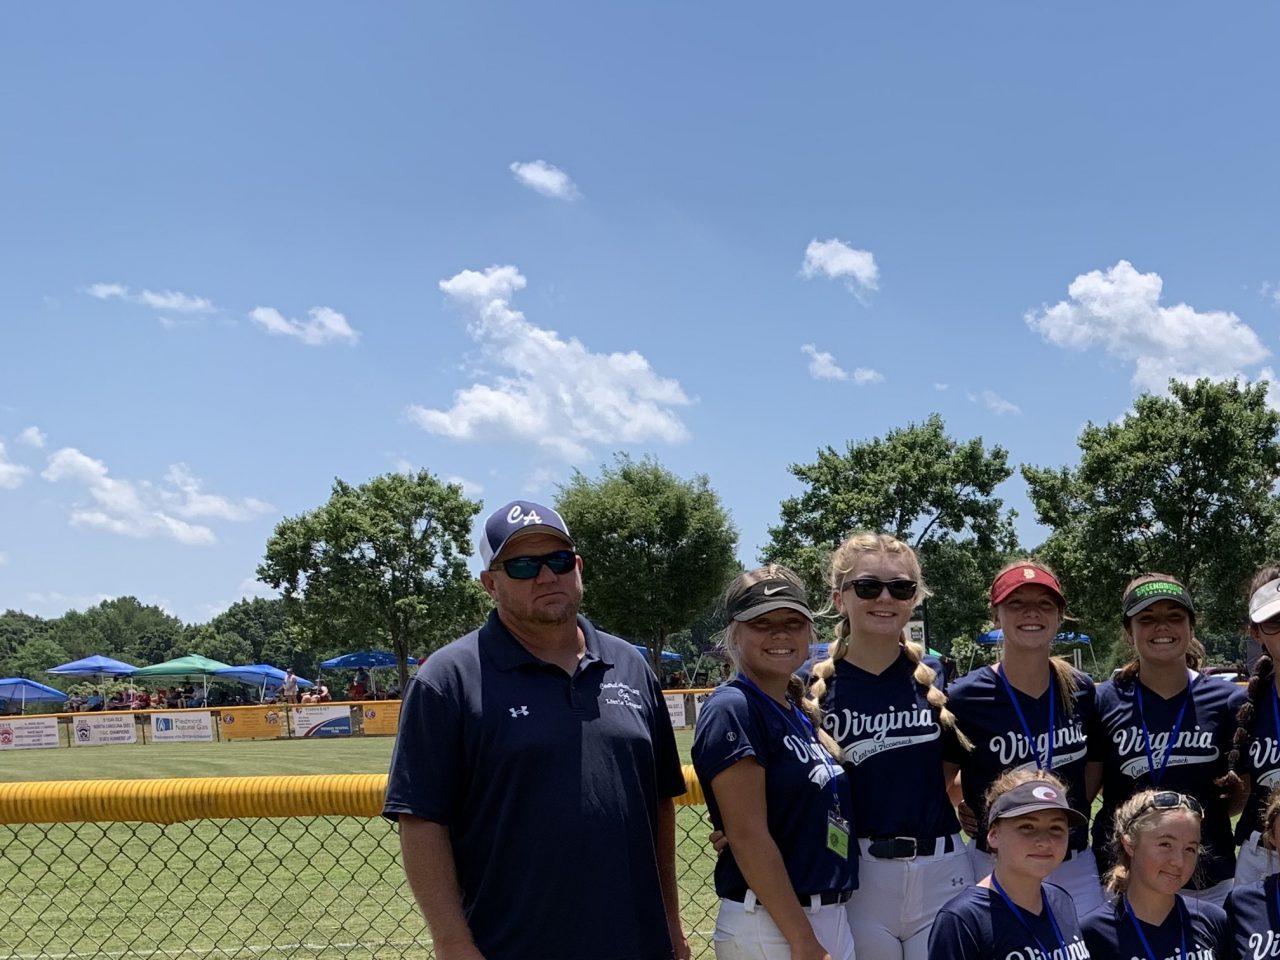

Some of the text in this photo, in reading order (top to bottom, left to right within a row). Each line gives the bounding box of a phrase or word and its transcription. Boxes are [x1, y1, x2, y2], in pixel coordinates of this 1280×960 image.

[507, 505, 542, 525] CA
[823, 703, 936, 743] Virginia
[852, 741, 878, 764] Central
